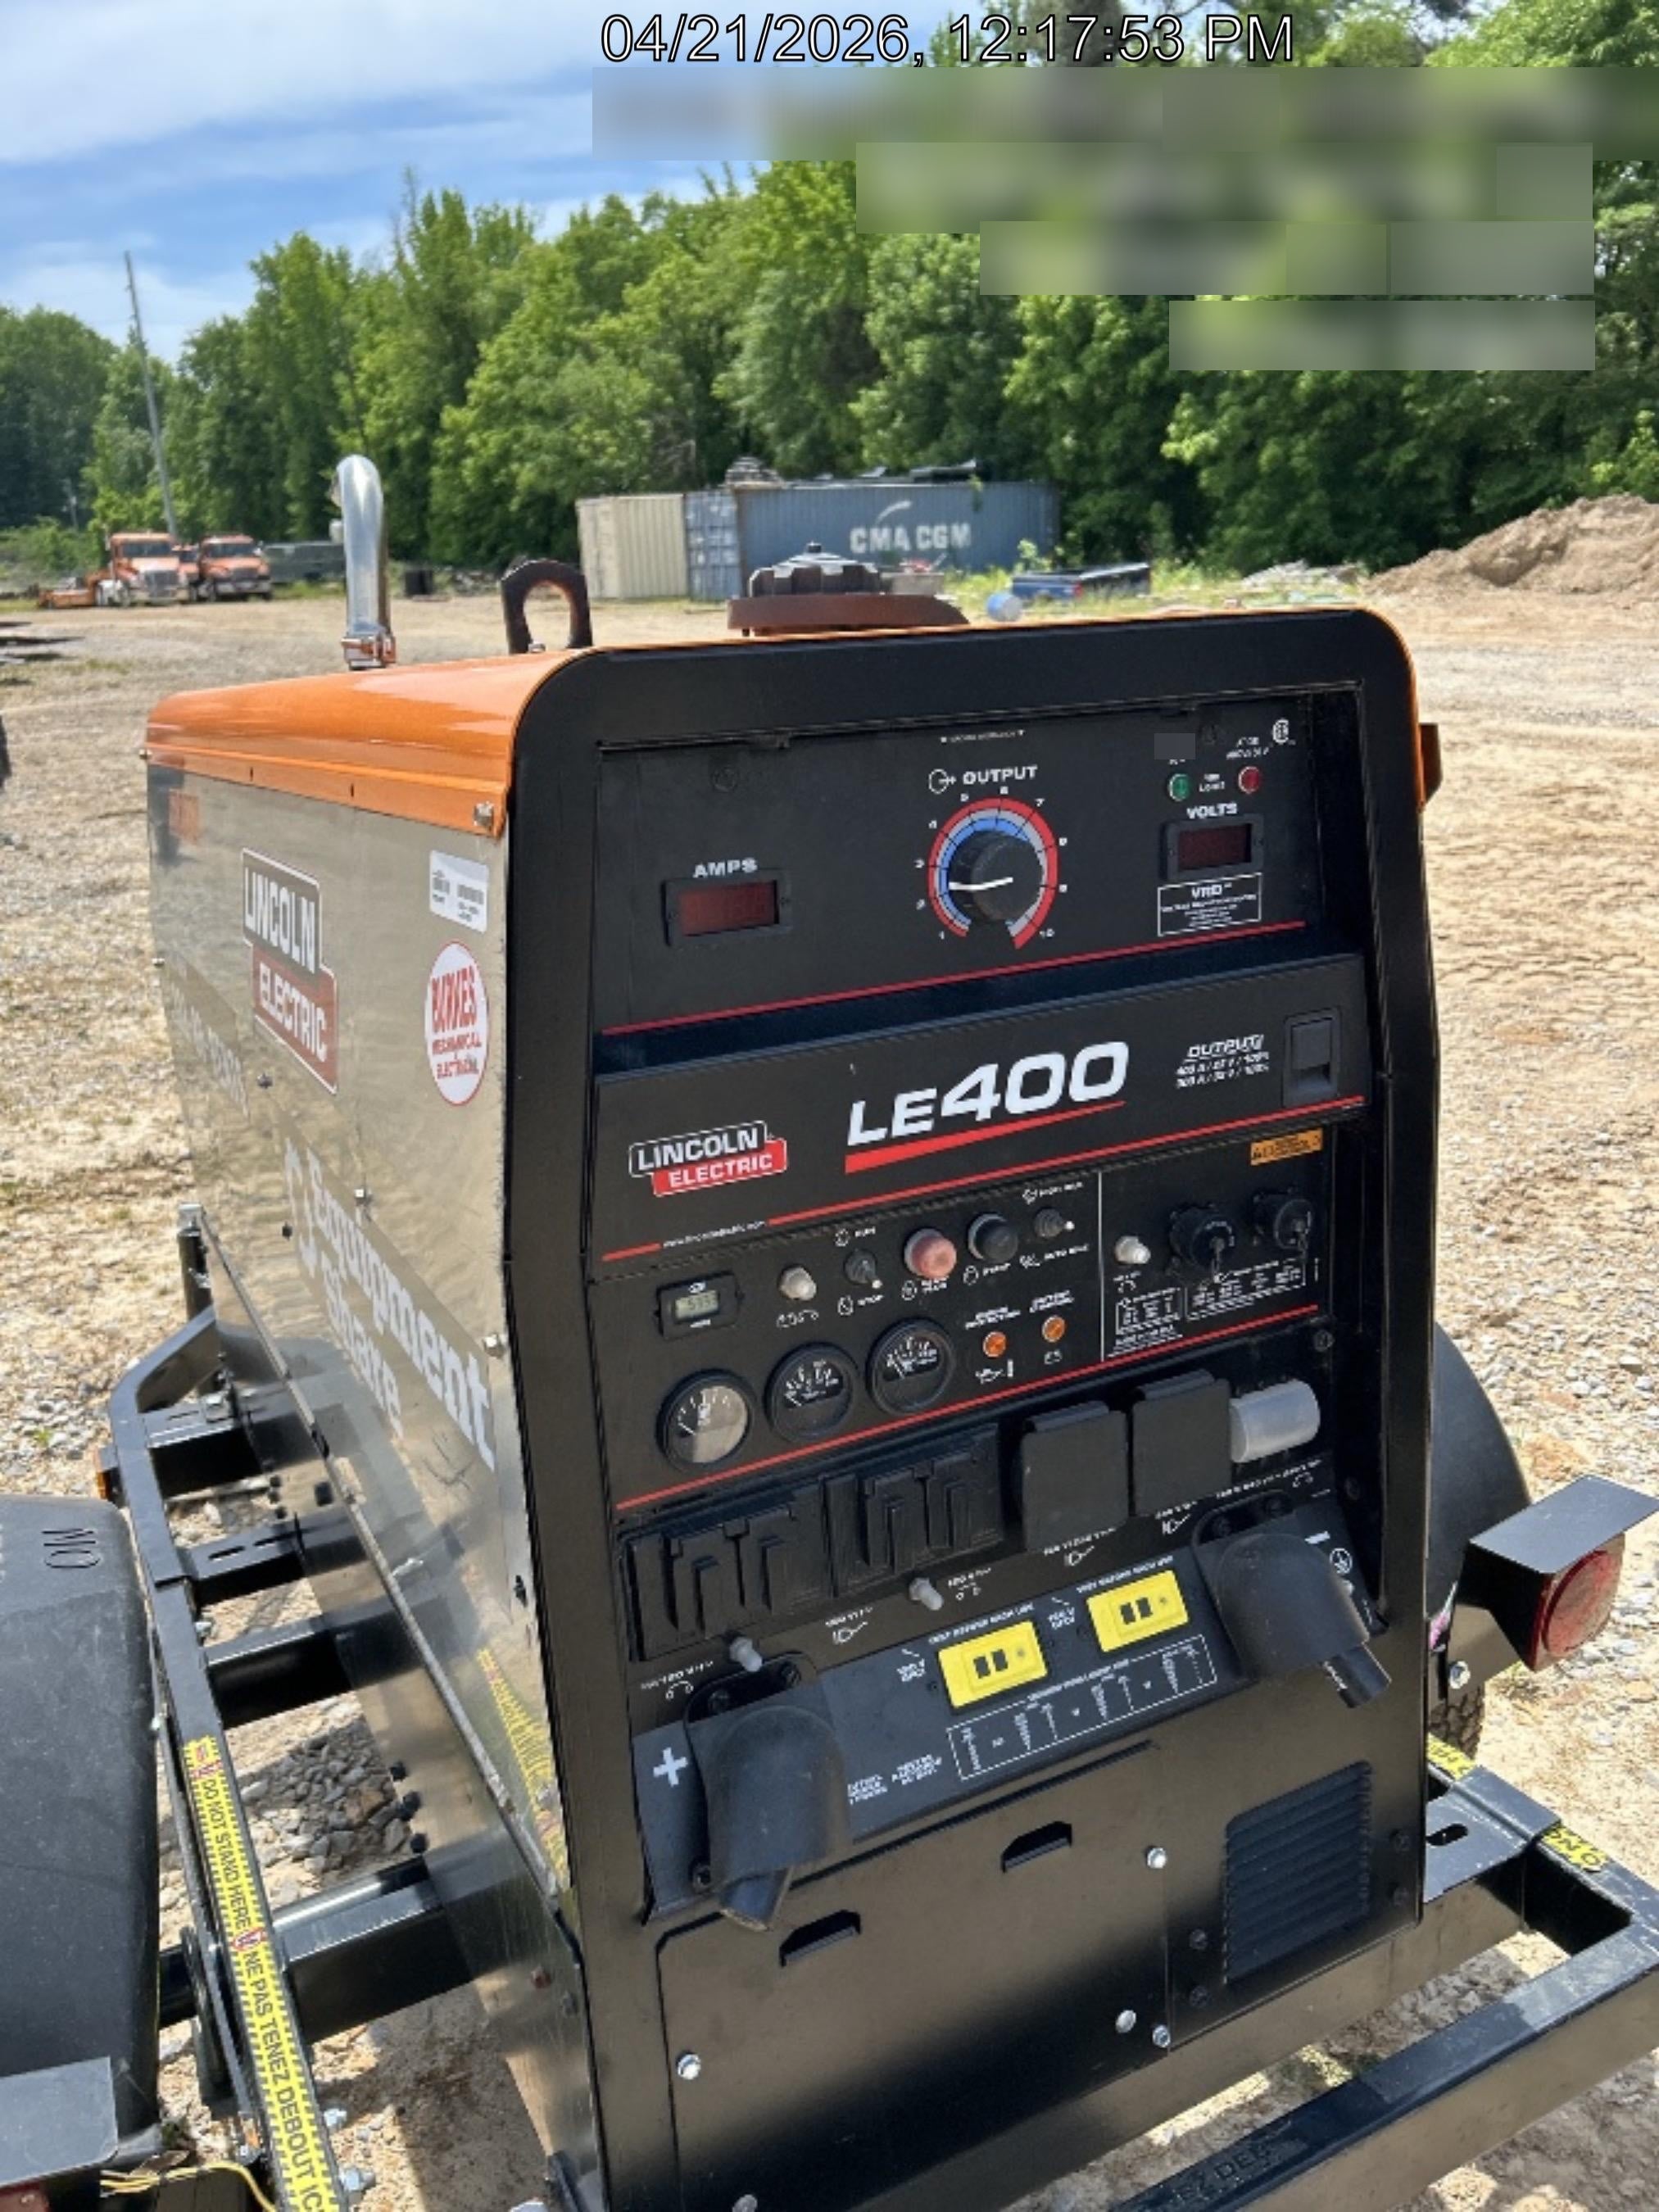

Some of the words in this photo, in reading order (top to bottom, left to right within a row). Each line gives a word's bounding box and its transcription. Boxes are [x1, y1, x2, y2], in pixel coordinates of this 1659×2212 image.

[850, 524, 910, 554] CMA
[915, 522, 972, 549] CGM
[962, 764, 1038, 786] OUTPUT
[1186, 802, 1238, 819] VOLTS
[692, 857, 759, 879] AMPS
[244, 867, 316, 974] LINCOLN
[259, 962, 329, 1063] ELECTRIC
[1187, 1033, 1264, 1058] OUTPUT
[847, 1040, 1130, 1147] LE400
[637, 1126, 759, 1172] LINCOLN
[668, 1152, 774, 1190] ELECTRIC
[201, 1779, 220, 1800] DO
[208, 1800, 228, 1830] NOT
[215, 1830, 241, 1884] STAND
[228, 1883, 252, 1929] HERE
[243, 1949, 265, 1983] NE
[250, 1979, 274, 2017] PAS
[259, 2015, 292, 2084] TENEZ
[274, 2086, 317, 2179] DEBOUT
